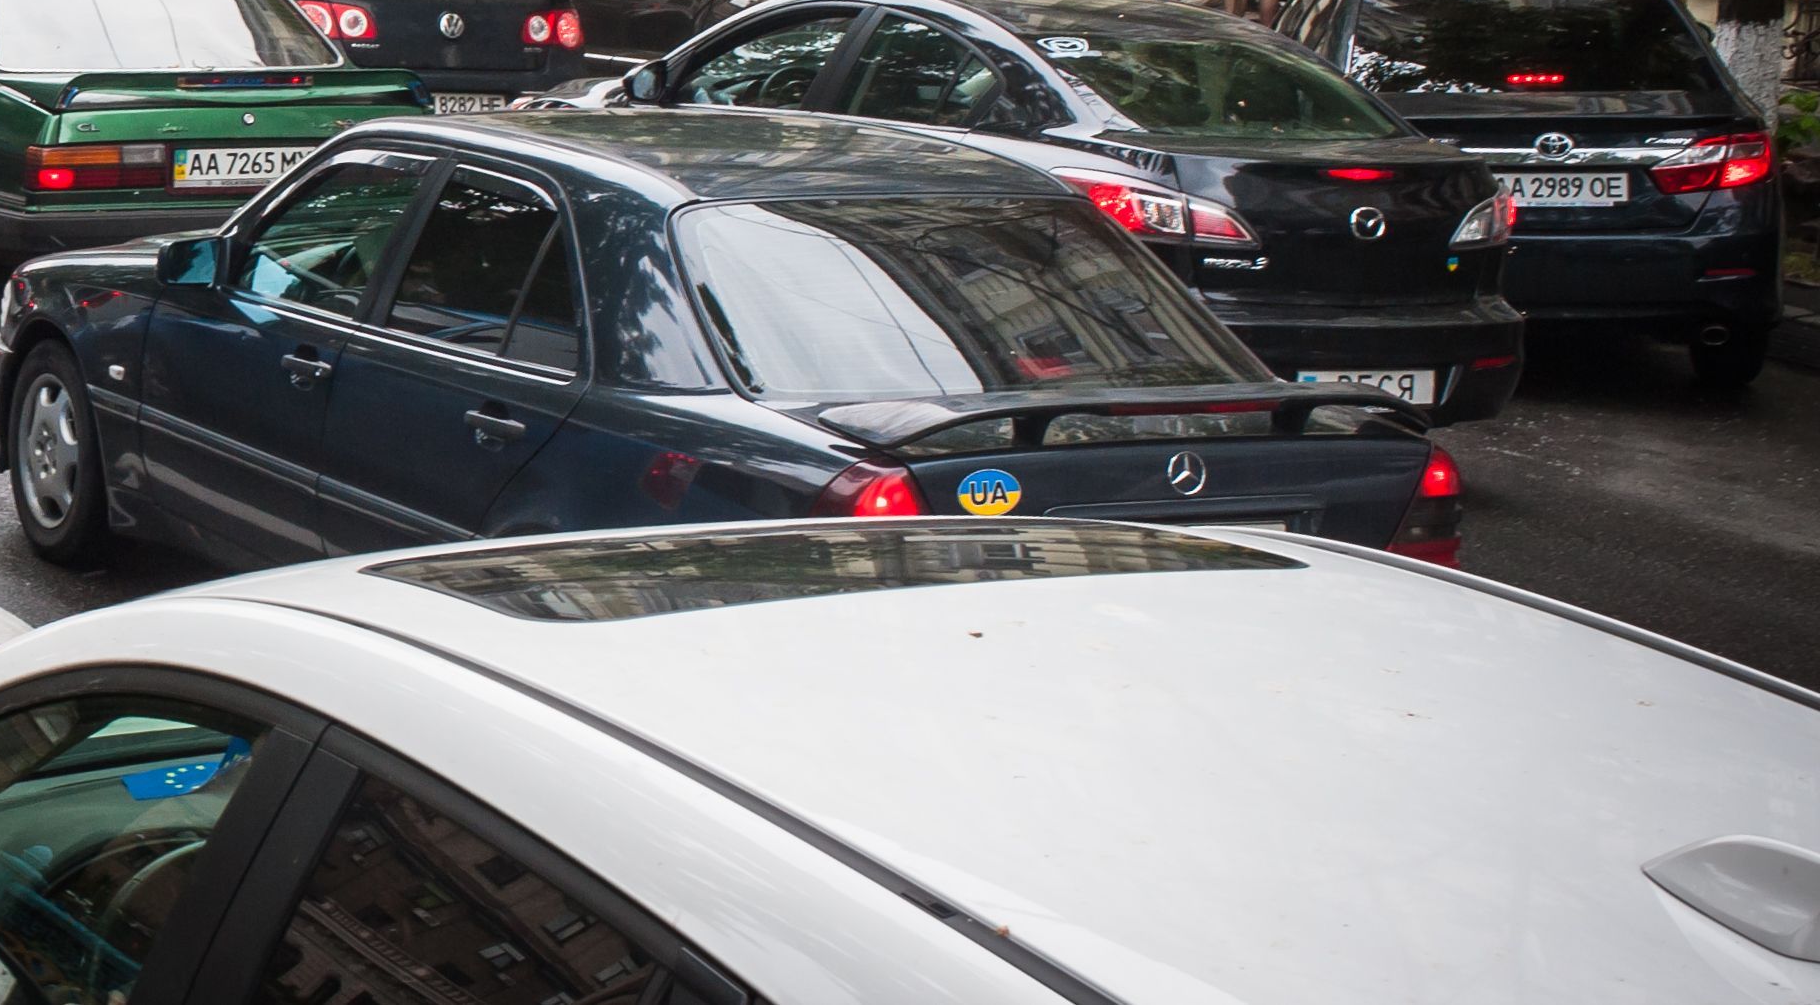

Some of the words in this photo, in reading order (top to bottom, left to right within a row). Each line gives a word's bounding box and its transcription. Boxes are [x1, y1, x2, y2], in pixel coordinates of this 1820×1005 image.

[439, 96, 475, 113] 8282
[189, 153, 220, 175] AA
[226, 152, 275, 175] 7265
[281, 152, 313, 173] M
[1531, 177, 1584, 198] 2989
[1590, 177, 1623, 198] OE
[970, 481, 1008, 506] UA
